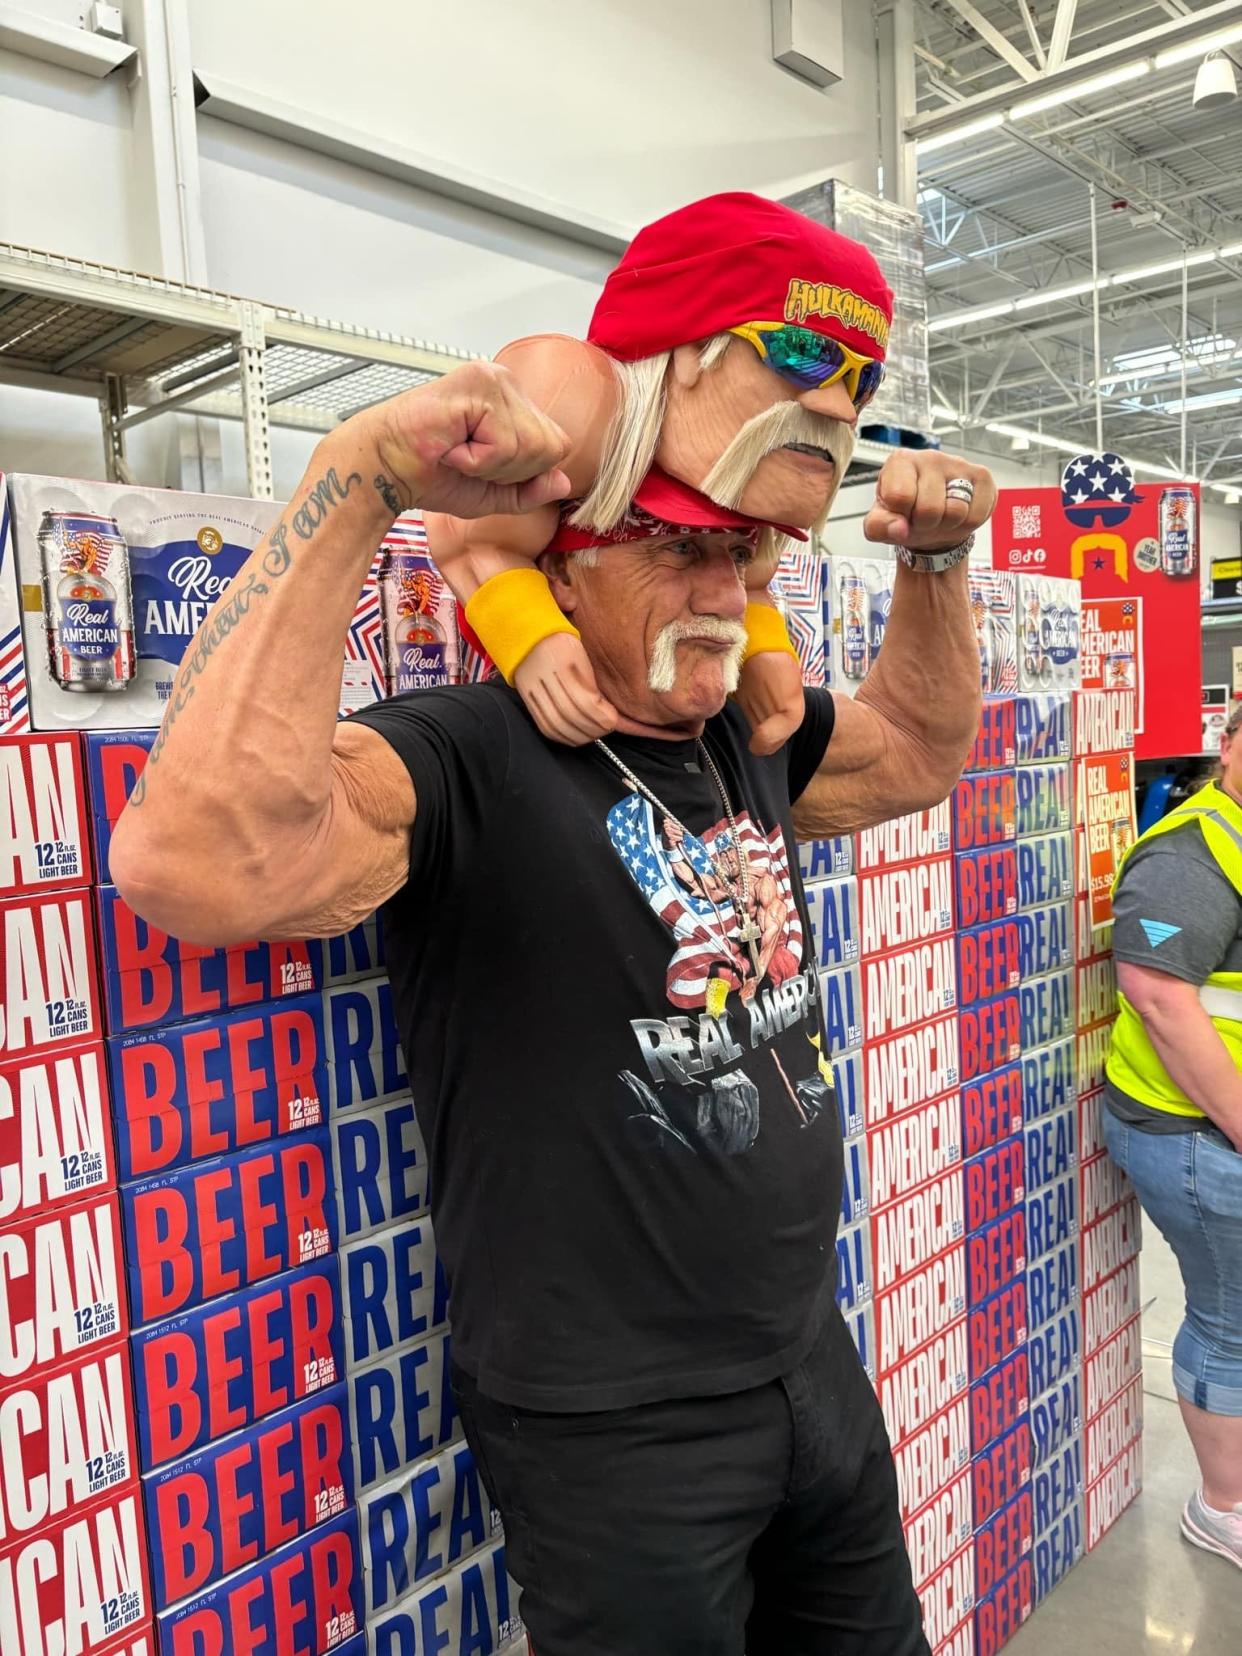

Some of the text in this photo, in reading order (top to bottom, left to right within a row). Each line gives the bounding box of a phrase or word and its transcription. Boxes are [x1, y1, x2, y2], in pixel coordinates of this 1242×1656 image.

[292, 466, 362, 541] am
[66, 603, 109, 626] Real
[144, 599, 216, 635] AME
[62, 627, 118, 643] AMERICAN
[80, 645, 103, 655] BEER
[403, 648, 439, 672] Real
[399, 673, 448, 690] AMERICAN
[1076, 690, 1135, 756] AMERICAN
[1088, 765, 1108, 796] REAL
[957, 774, 1016, 849] BEER
[1089, 790, 1130, 825] AMERICAN
[1090, 822, 1110, 853] BEER
[35, 842, 64, 867] 12 12
[57, 852, 77, 865] CANS
[39, 864, 78, 879] LIGHT BEER
[960, 849, 1018, 928] BEER
[862, 860, 952, 954] AMERICAN
[280, 962, 295, 984] 12
[296, 971, 312, 981] CANS
[959, 922, 1019, 1005] BEER
[282, 980, 312, 995] LIGHT BEER
[867, 938, 956, 1039] AMERICAN
[46, 1000, 75, 1025] 12 12
[67, 1009, 88, 1022] CANS
[50, 1020, 89, 1038] LIGHT BEER
[960, 996, 1020, 1082] BEER
[630, 1009, 745, 1086] REAL
[868, 1017, 960, 1126] AMERICAN
[121, 1010, 322, 1176] BEER
[288, 1100, 303, 1120] 12
[289, 1115, 319, 1130] LIGHT BEER
[304, 1105, 320, 1116] CANS
[965, 1069, 1022, 1156] BEER
[871, 1093, 961, 1208] AMERICAN
[61, 1152, 89, 1179] 12 12
[82, 1160, 102, 1174] CANS
[64, 1171, 103, 1191] LIGHT BEER
[968, 1141, 1024, 1231] BEER
[133, 1144, 332, 1321] BEER
[298, 1231, 313, 1252] 12
[313, 1235, 329, 1248] CANS
[877, 1168, 963, 1290] AMERICAN
[299, 1245, 329, 1263] LIGHT BEER
[970, 1212, 1025, 1305] BEER
[0, 1203, 120, 1378] CAN
[74, 1303, 102, 1332] 12 12
[95, 1310, 115, 1325] CANS
[880, 1244, 966, 1373] AMERICAN
[78, 1321, 116, 1344] LIGHT BEER
[971, 1282, 1026, 1378] BEER
[143, 1275, 338, 1466] BEER
[304, 1361, 318, 1381] 12
[319, 1364, 334, 1378] CANS
[305, 1374, 335, 1393] LIGHT BEER
[973, 1353, 1028, 1453] BEER
[0, 1352, 130, 1540] CAN
[86, 1452, 113, 1482] 12 12
[106, 1458, 125, 1474] CANS
[975, 1423, 1030, 1526] BEER
[89, 1469, 126, 1493] LIGHT BEER
[156, 1404, 348, 1604] BEER
[315, 1490, 328, 1511] 12
[329, 1492, 344, 1506] CANS
[316, 1502, 345, 1523] LIGHT BEER
[977, 1492, 1031, 1597] BEER
[101, 1593, 127, 1624] 12 12
[121, 1598, 140, 1615] CANS
[978, 1560, 1031, 1656] BEER
[105, 1609, 141, 1635] LIGHT BEER
[326, 1616, 339, 1637] 12
[340, 1617, 355, 1631] CANS
[327, 1627, 355, 1648] LIGHT BEER
